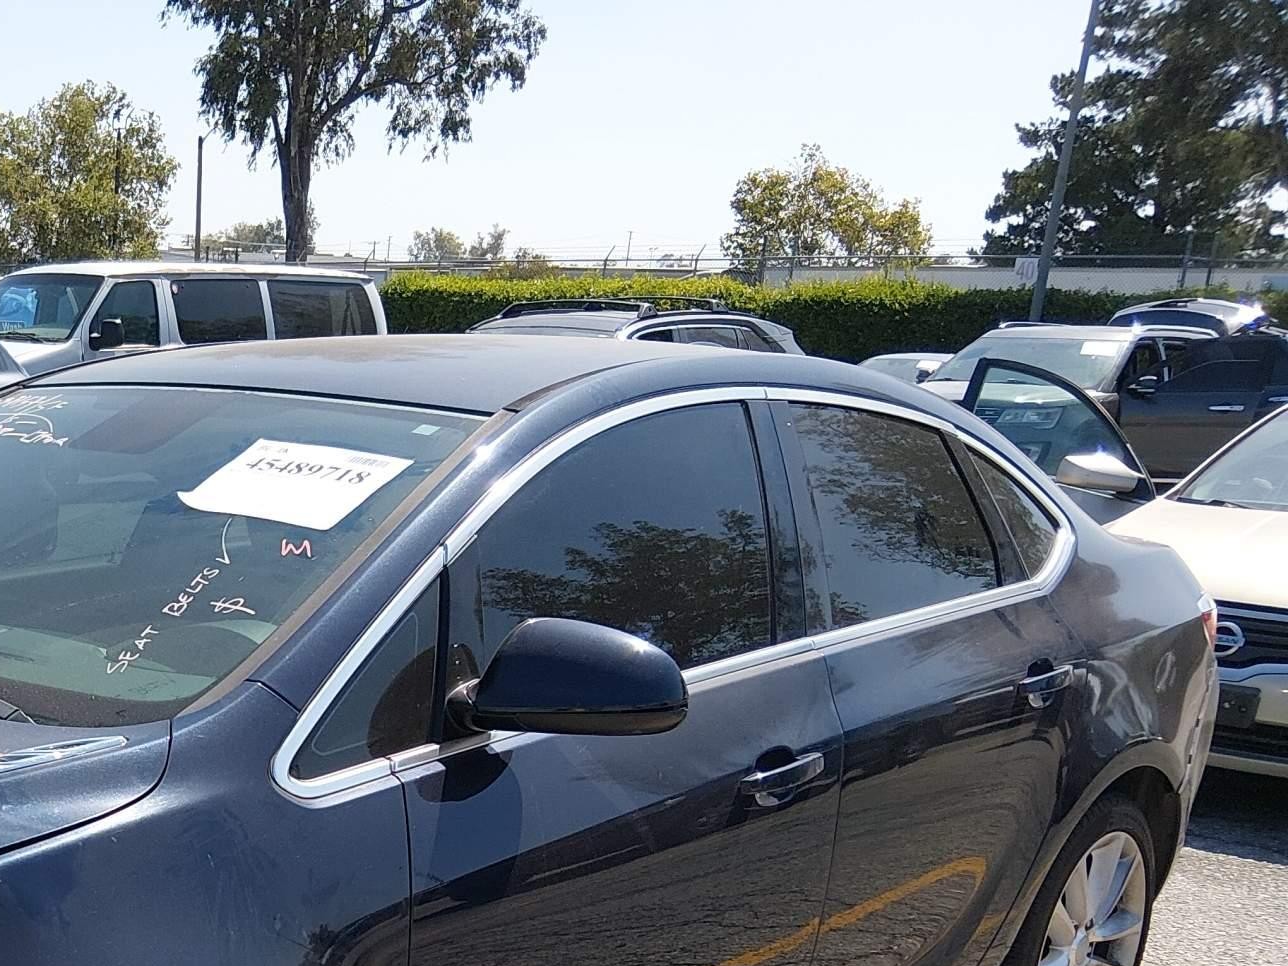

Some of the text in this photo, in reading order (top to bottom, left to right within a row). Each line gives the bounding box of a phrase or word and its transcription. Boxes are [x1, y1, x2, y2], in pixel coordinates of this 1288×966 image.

[1016, 261, 1034, 280] 40
[245, 457, 372, 484] 45489718
[107, 566, 220, 674] SEAT BELTS
